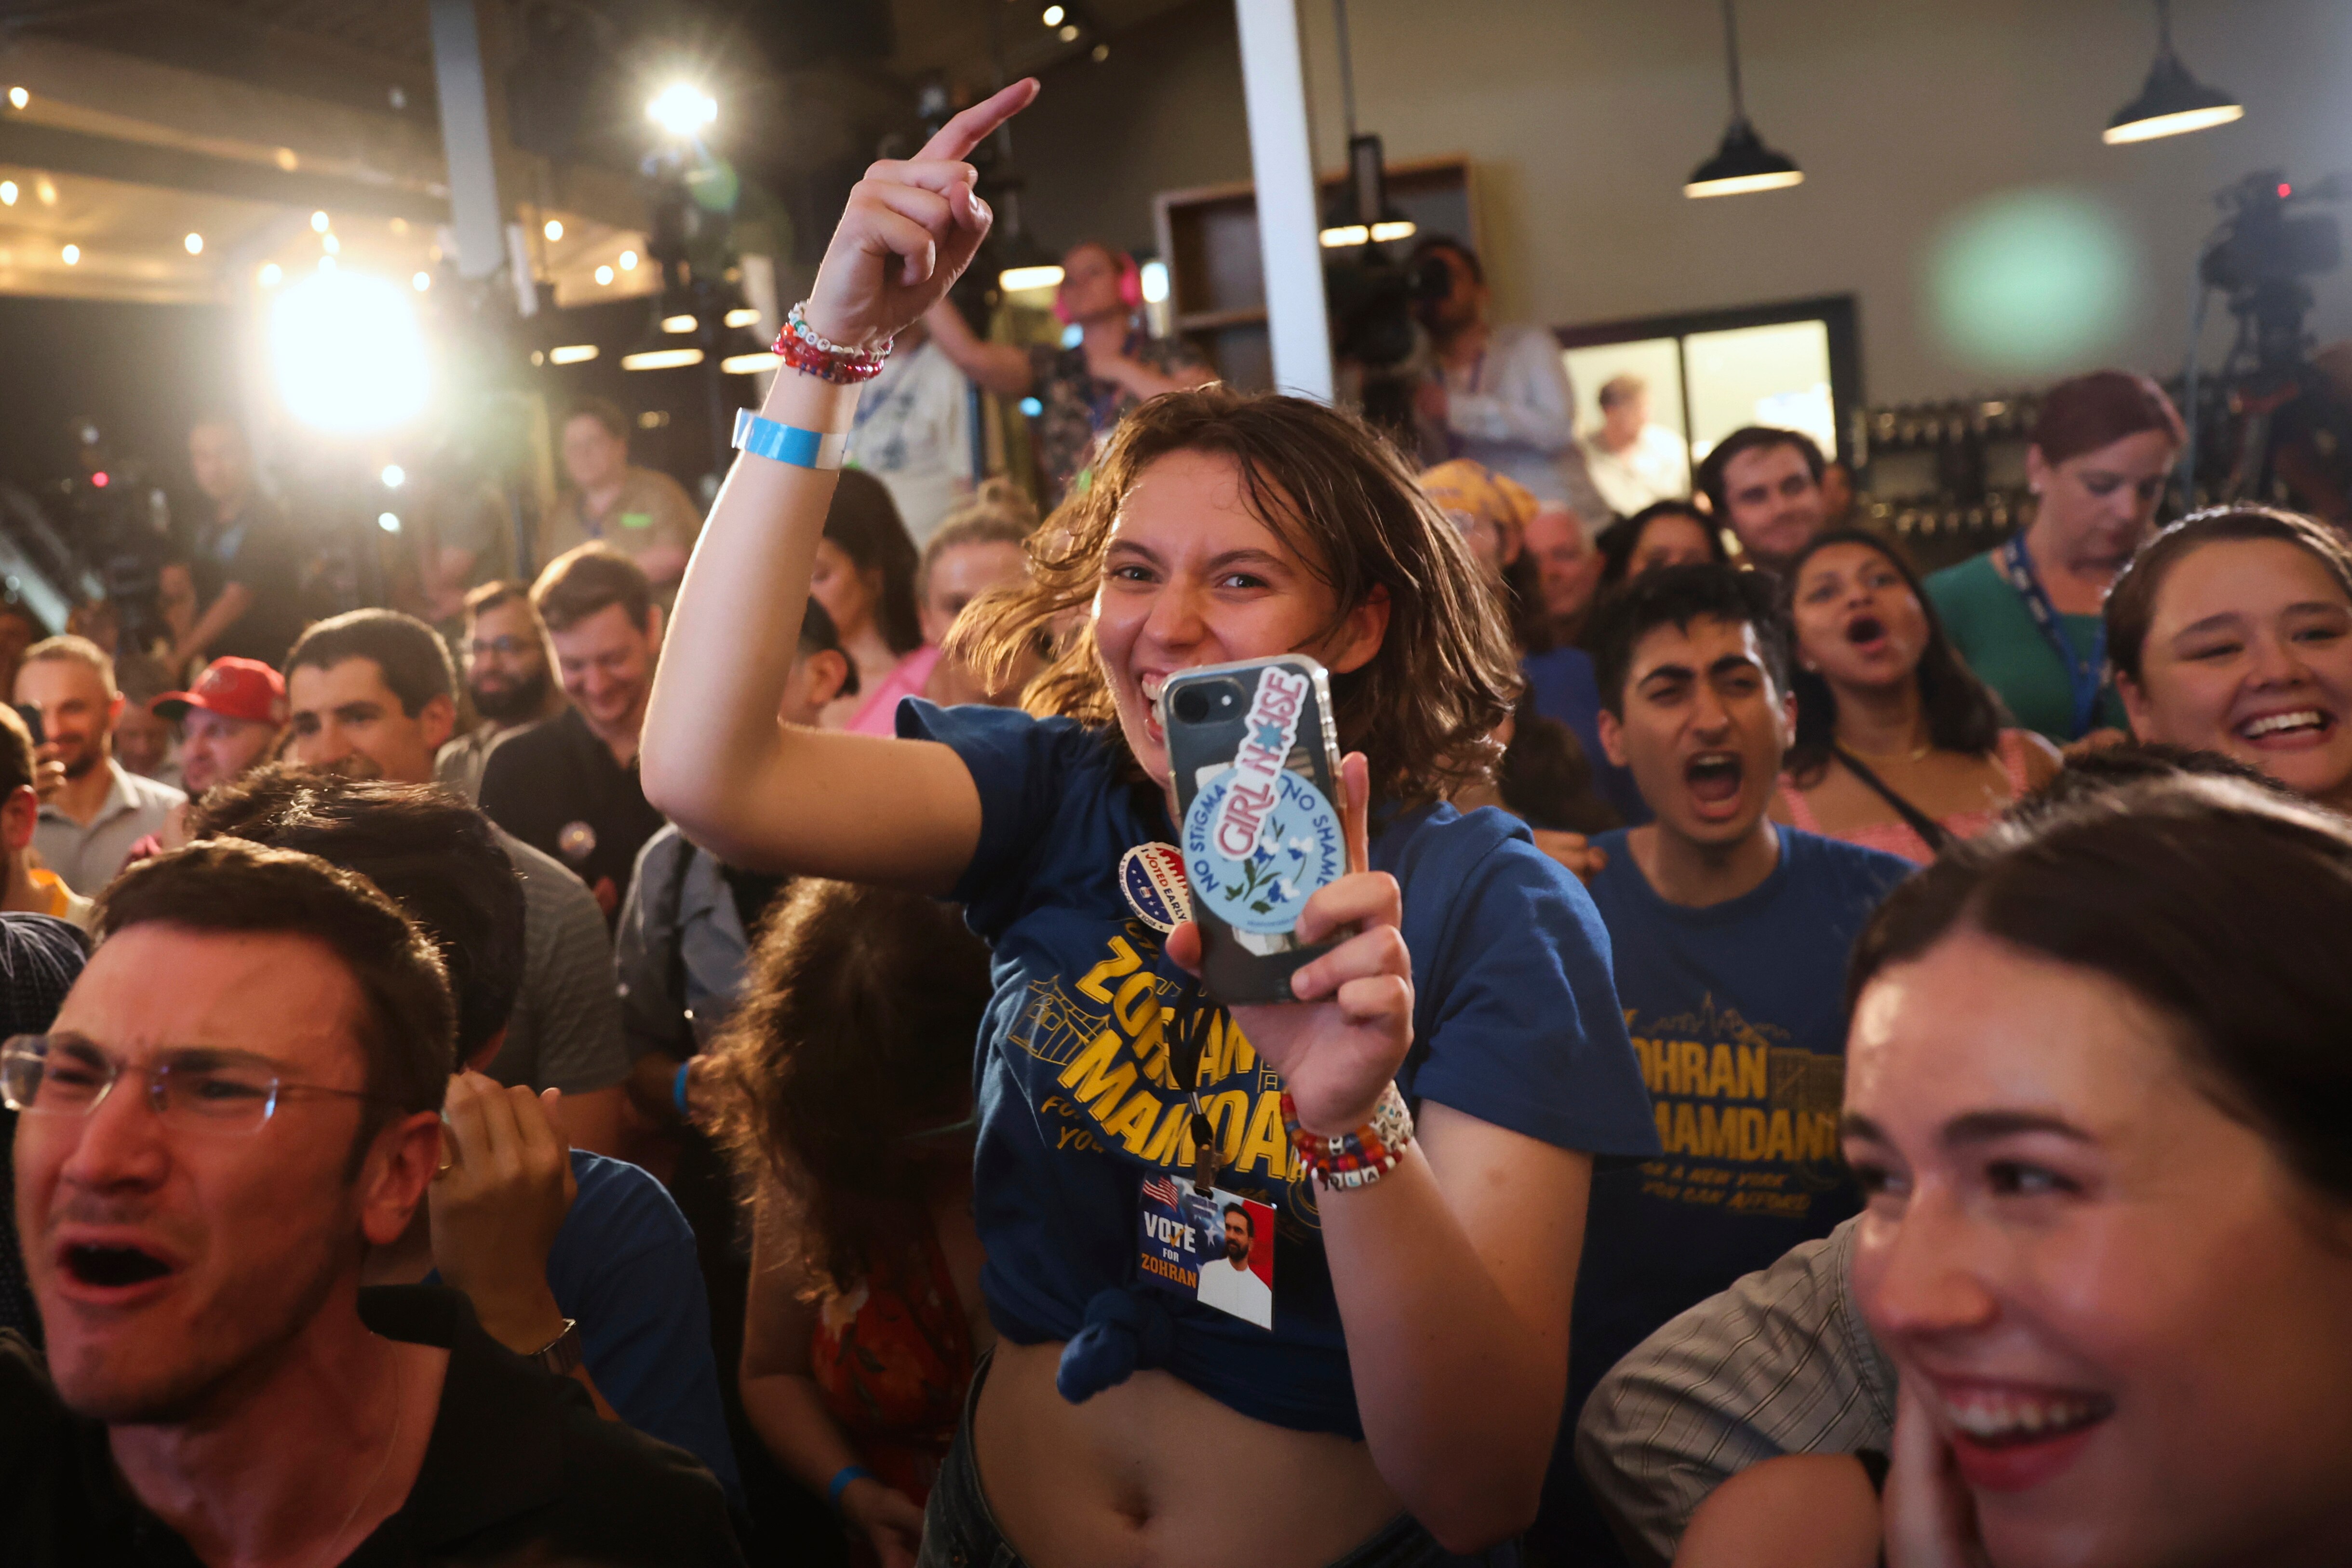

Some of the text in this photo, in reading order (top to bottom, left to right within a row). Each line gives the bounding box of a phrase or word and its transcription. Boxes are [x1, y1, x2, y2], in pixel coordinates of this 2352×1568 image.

[1242, 673, 1304, 777] NISE
[1194, 859, 1221, 893] NO
[1281, 774, 1316, 811] NO
[1218, 783, 1275, 856] GIRL
[1145, 853, 1169, 887] VOTED
[1141, 914, 1157, 926] YORK
[1144, 1211, 1196, 1253] VOTE
[1141, 1253, 1198, 1288] ZOHRAN
[1163, 1247, 1179, 1262] FOR
